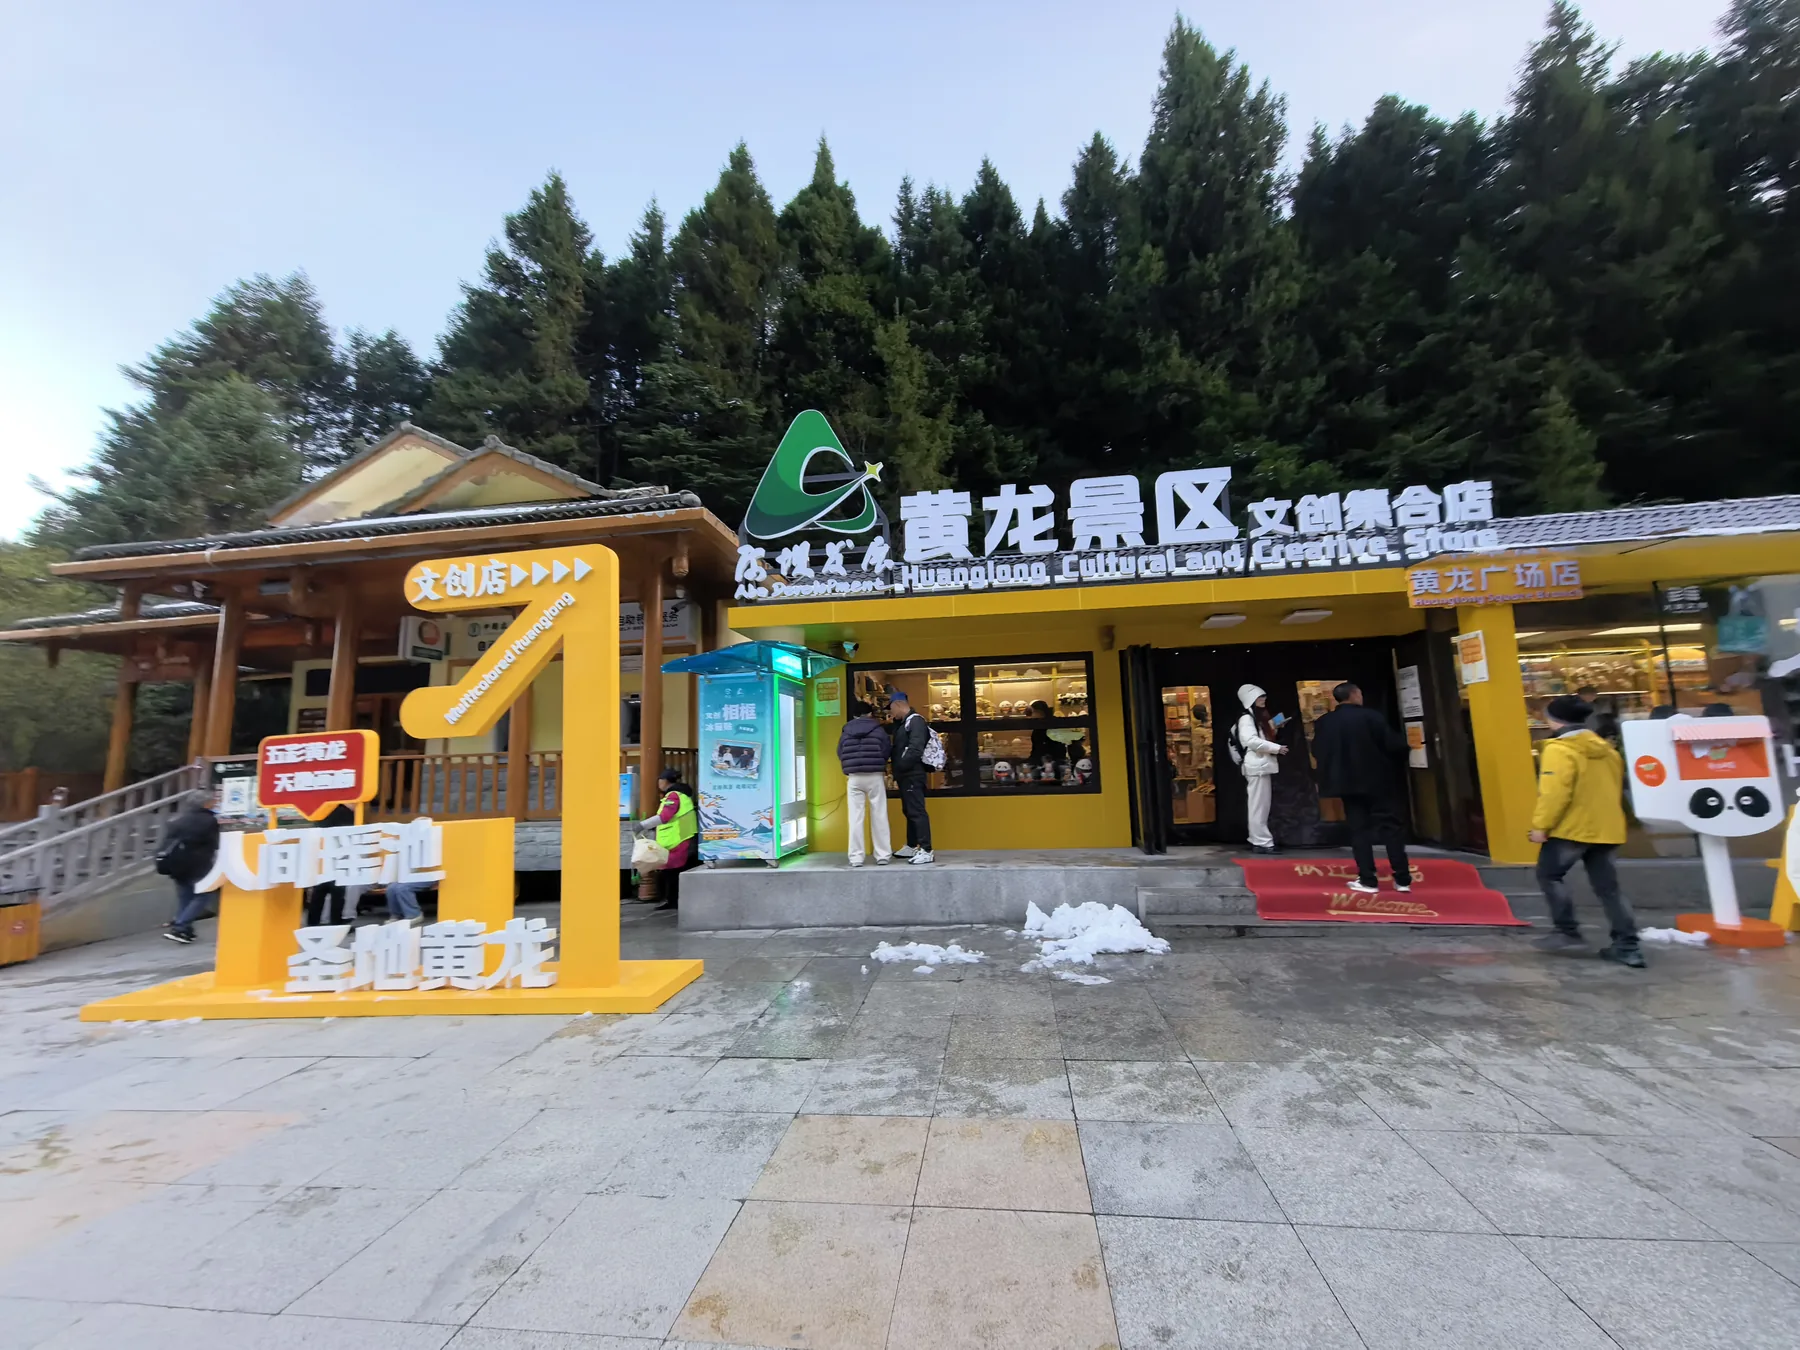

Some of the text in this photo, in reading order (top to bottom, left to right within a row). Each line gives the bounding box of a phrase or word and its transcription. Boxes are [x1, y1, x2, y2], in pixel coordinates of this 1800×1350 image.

[900, 466, 1482, 563] 黄龙景区 文创集合店
[412, 558, 509, 602] 文创店
[902, 528, 1498, 591] Huanglong Cultural and Creative Store
[1411, 561, 1580, 595] 黄龙广场店
[1416, 594, 1485, 606] Huanglong
[445, 591, 576, 725] Multicolored Huanglong
[723, 703, 757, 720] 相框
[194, 818, 446, 895] 人间瑶池
[1330, 892, 1429, 914] Welcome
[287, 917, 557, 992] 圣地黄龙
